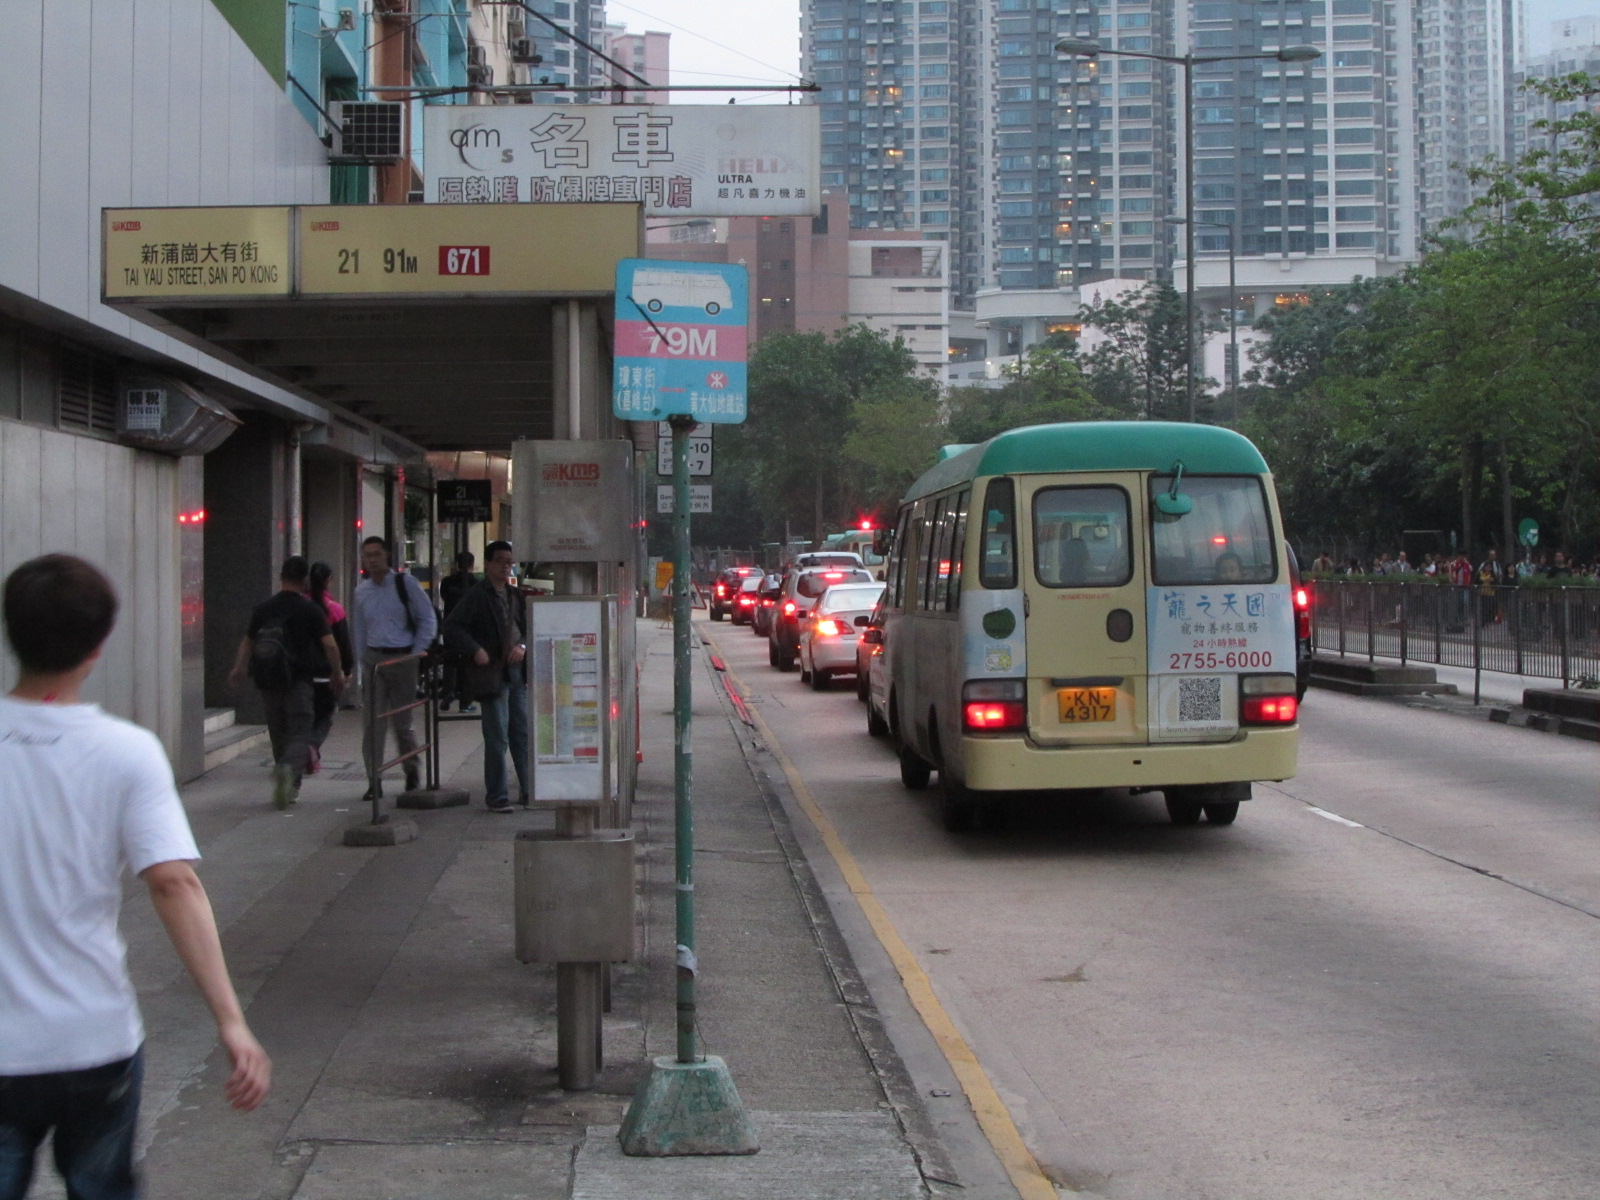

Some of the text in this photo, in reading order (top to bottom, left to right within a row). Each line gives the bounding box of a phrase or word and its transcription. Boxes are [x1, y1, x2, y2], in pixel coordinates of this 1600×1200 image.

[530, 112, 674, 168] 名車
[718, 175, 753, 184] ULTRA
[717, 187, 806, 199] 超凡喜力機油
[119, 221, 142, 231] KMB
[318, 221, 340, 231] KMB
[141, 241, 258, 265] 新蒲崗大有街
[338, 247, 481, 274] 21 91M 671
[124, 268, 139, 286] TAI
[144, 268, 163, 286] YAU
[208, 265, 228, 284] SAN
[232, 265, 246, 284] PO
[250, 264, 278, 283] KONG
[643, 326, 717, 357] 79M
[559, 463, 600, 480] KMB
[1181, 622, 1260, 635] 寵物善終服務
[1170, 651, 1272, 669] 2755-6000
[1074, 691, 1101, 706] KN
[1065, 705, 1111, 721] 4317
